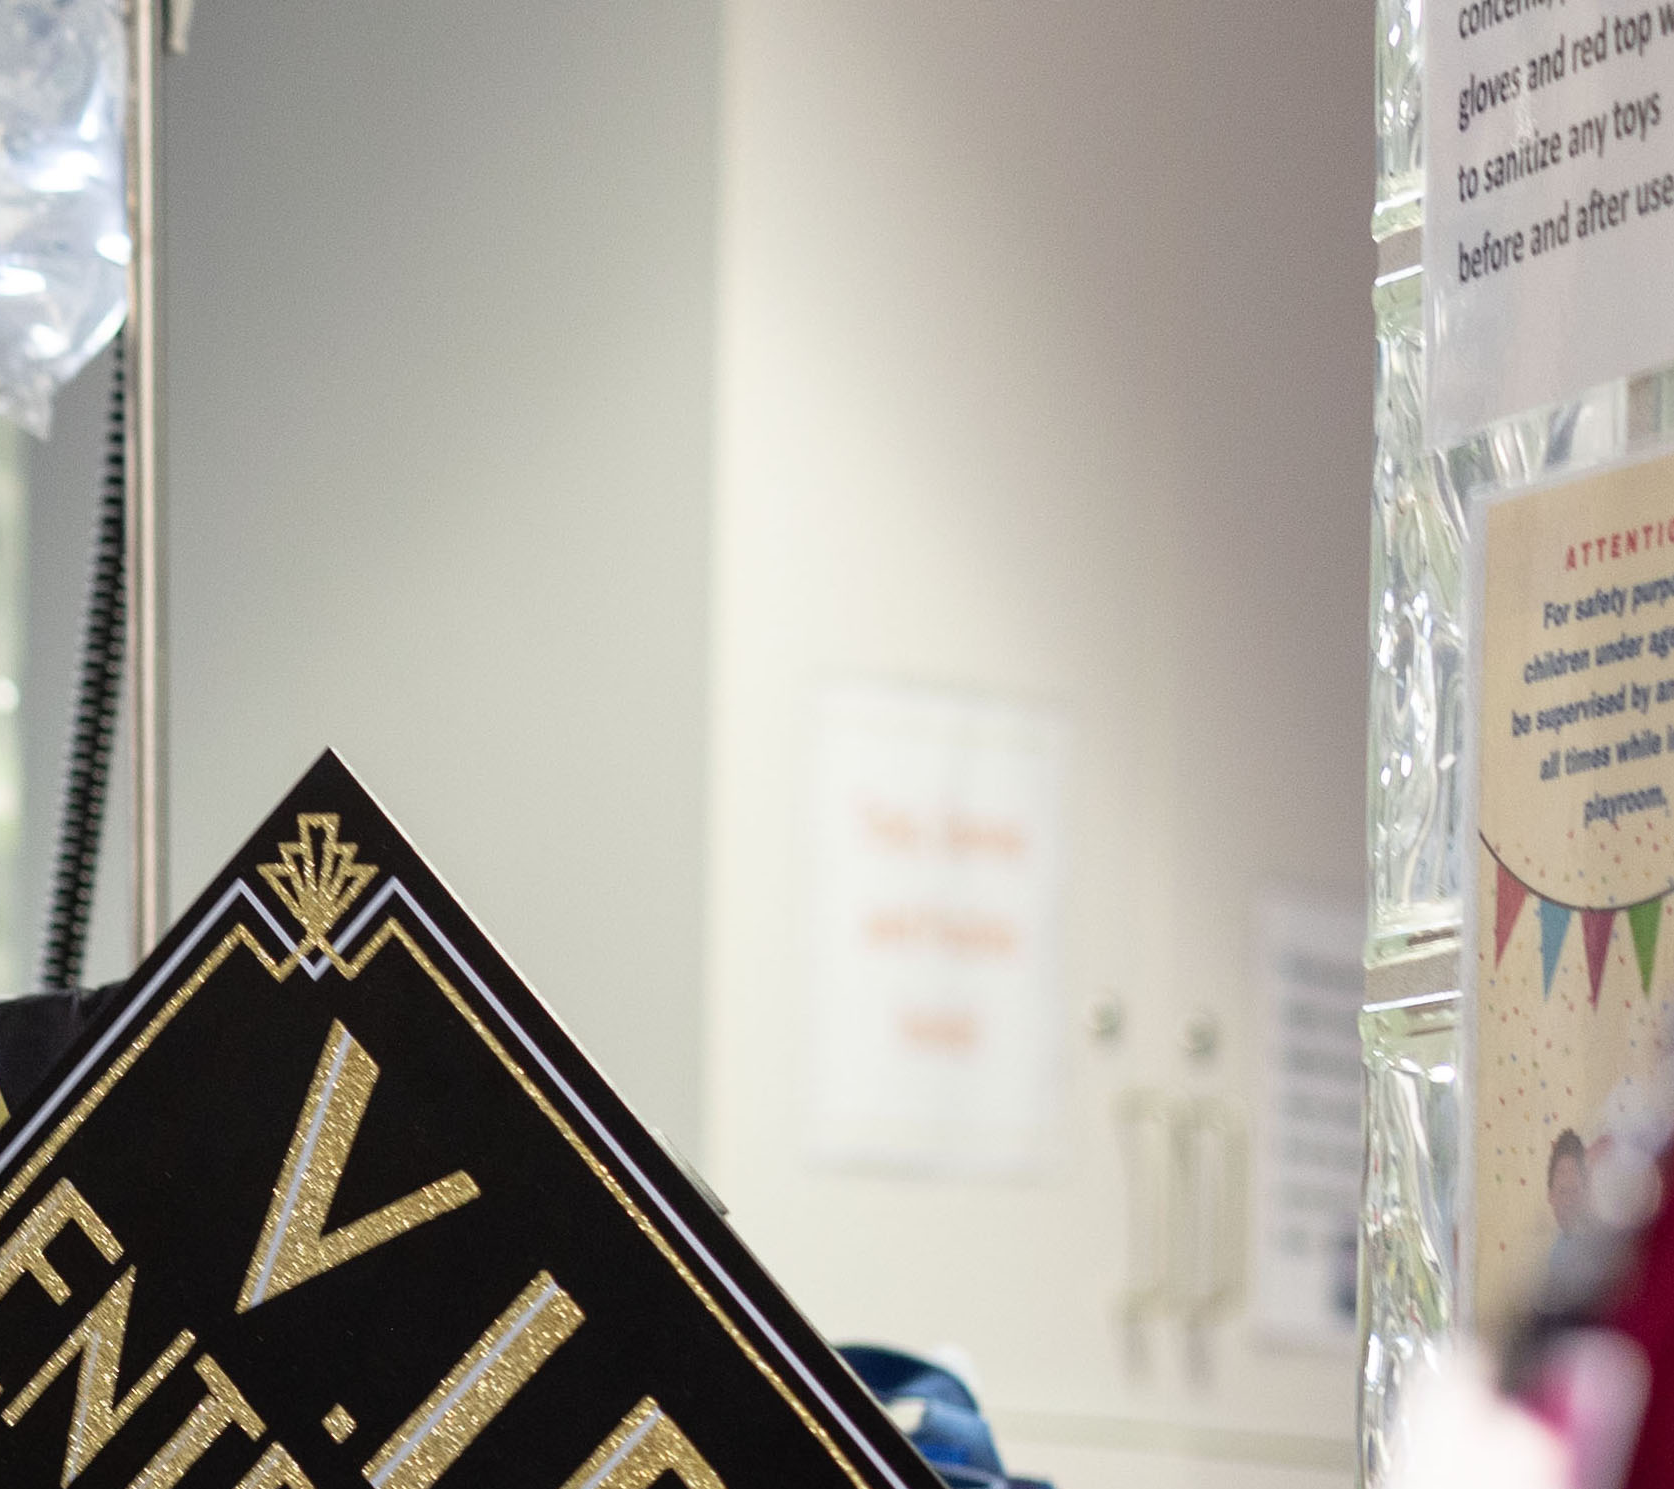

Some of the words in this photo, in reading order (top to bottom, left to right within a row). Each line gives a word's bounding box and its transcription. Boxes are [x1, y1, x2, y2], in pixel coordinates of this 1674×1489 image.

[1457, 66, 1520, 131] gloves
[1527, 36, 1565, 90] and
[1572, 18, 1607, 72] red
[1614, 13, 1652, 57] top
[1458, 165, 1478, 202] to
[1484, 129, 1561, 192] sanitize
[1569, 109, 1606, 157] any
[1613, 92, 1663, 142] toys
[1458, 230, 1524, 283] before
[1530, 201, 1570, 255] and
[1576, 188, 1631, 239] after
[1544, 602, 1571, 629] For
[1576, 586, 1625, 621] safety
[1524, 648, 1589, 684] children
[1596, 632, 1643, 666] under
[1512, 710, 1531, 736] be
[1536, 682, 1626, 734] supervised
[1631, 682, 1650, 715] by
[1540, 750, 1560, 781] all
[1565, 745, 1610, 775] times
[1617, 729, 1661, 763] while
